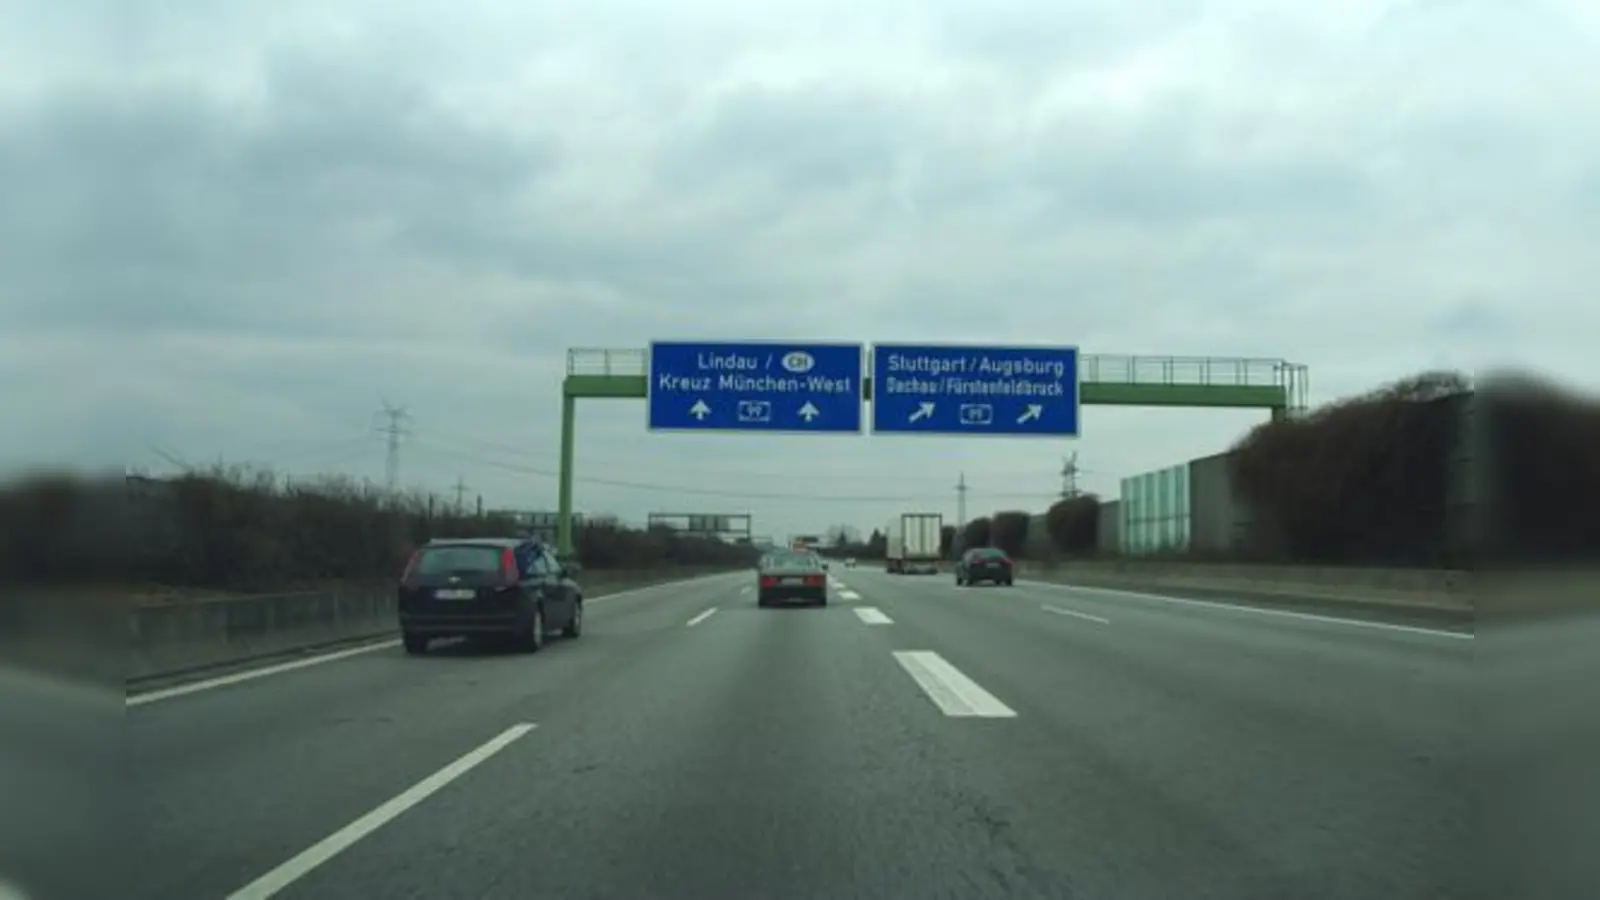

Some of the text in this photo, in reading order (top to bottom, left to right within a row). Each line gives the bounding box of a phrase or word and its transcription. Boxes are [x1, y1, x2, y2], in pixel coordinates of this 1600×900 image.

[697, 352, 758, 370] Lindau
[659, 374, 851, 393] Kreuz München-West
